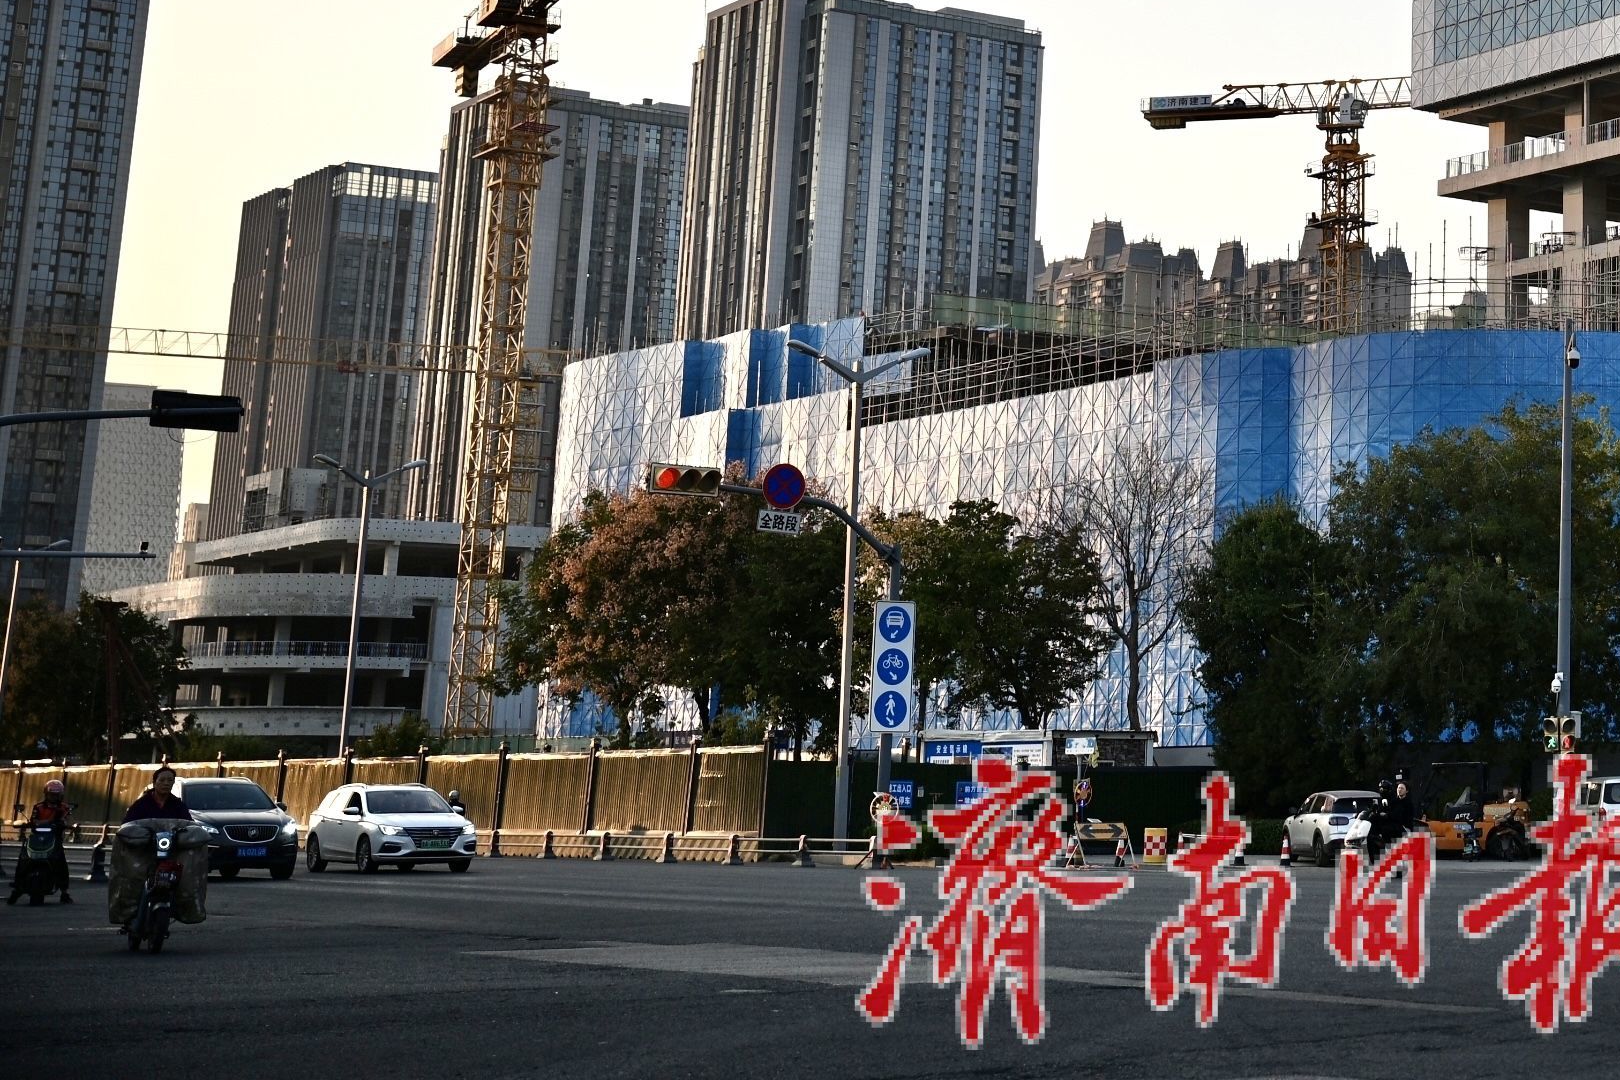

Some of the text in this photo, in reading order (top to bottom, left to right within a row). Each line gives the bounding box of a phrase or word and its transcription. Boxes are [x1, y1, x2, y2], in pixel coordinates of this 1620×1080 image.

[1167, 96, 1211, 107] 济南建工
[760, 513, 798, 531] 全路段
